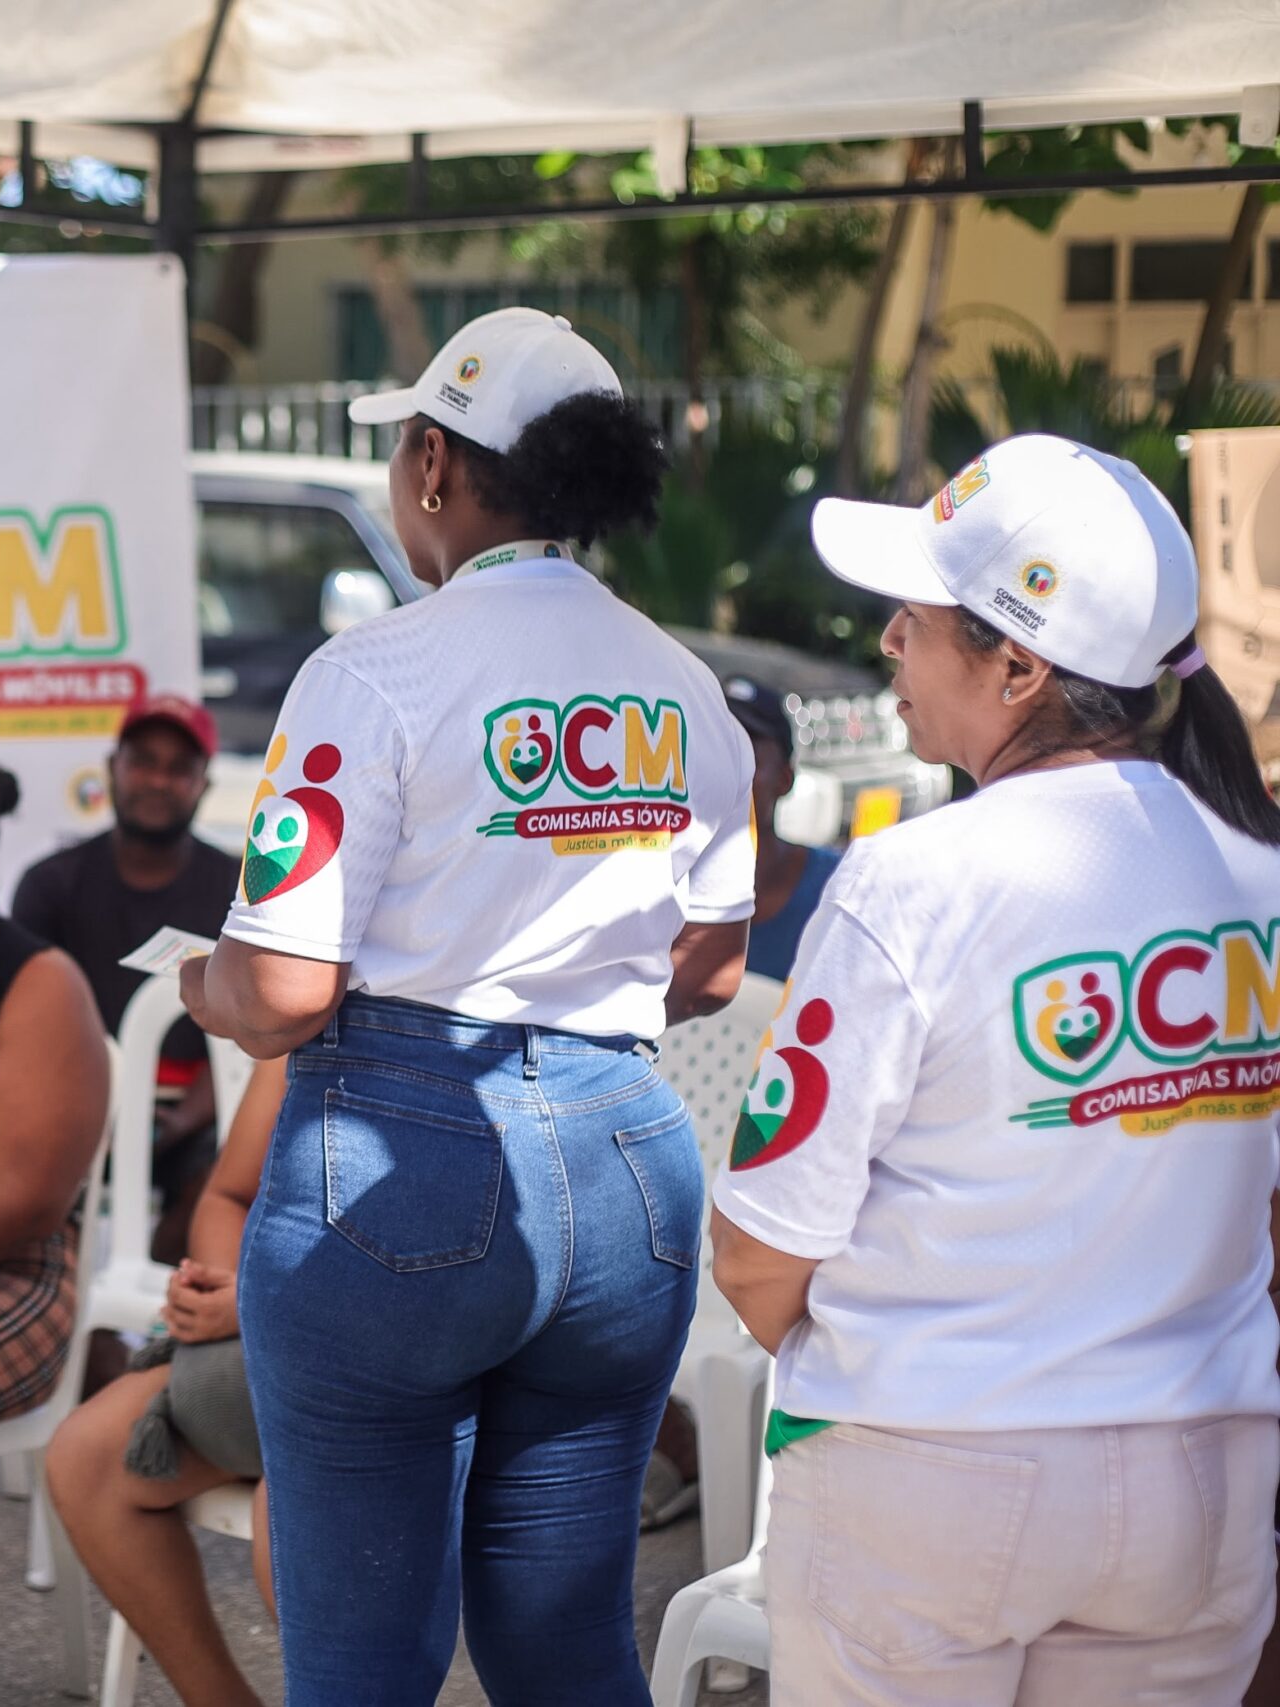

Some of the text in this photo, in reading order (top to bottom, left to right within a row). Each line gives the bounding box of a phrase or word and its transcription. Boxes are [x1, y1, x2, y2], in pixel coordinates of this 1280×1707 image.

[993, 595, 1007, 609] DE
[1005, 604, 1039, 632] FAMILIA
[996, 587, 1048, 626] COMISARIAS
[526, 805, 635, 833] COMISARÍAS
[564, 835, 607, 851] Justicia
[1083, 1067, 1231, 1118] COMISARÍAS
[1198, 1100, 1238, 1116] más
